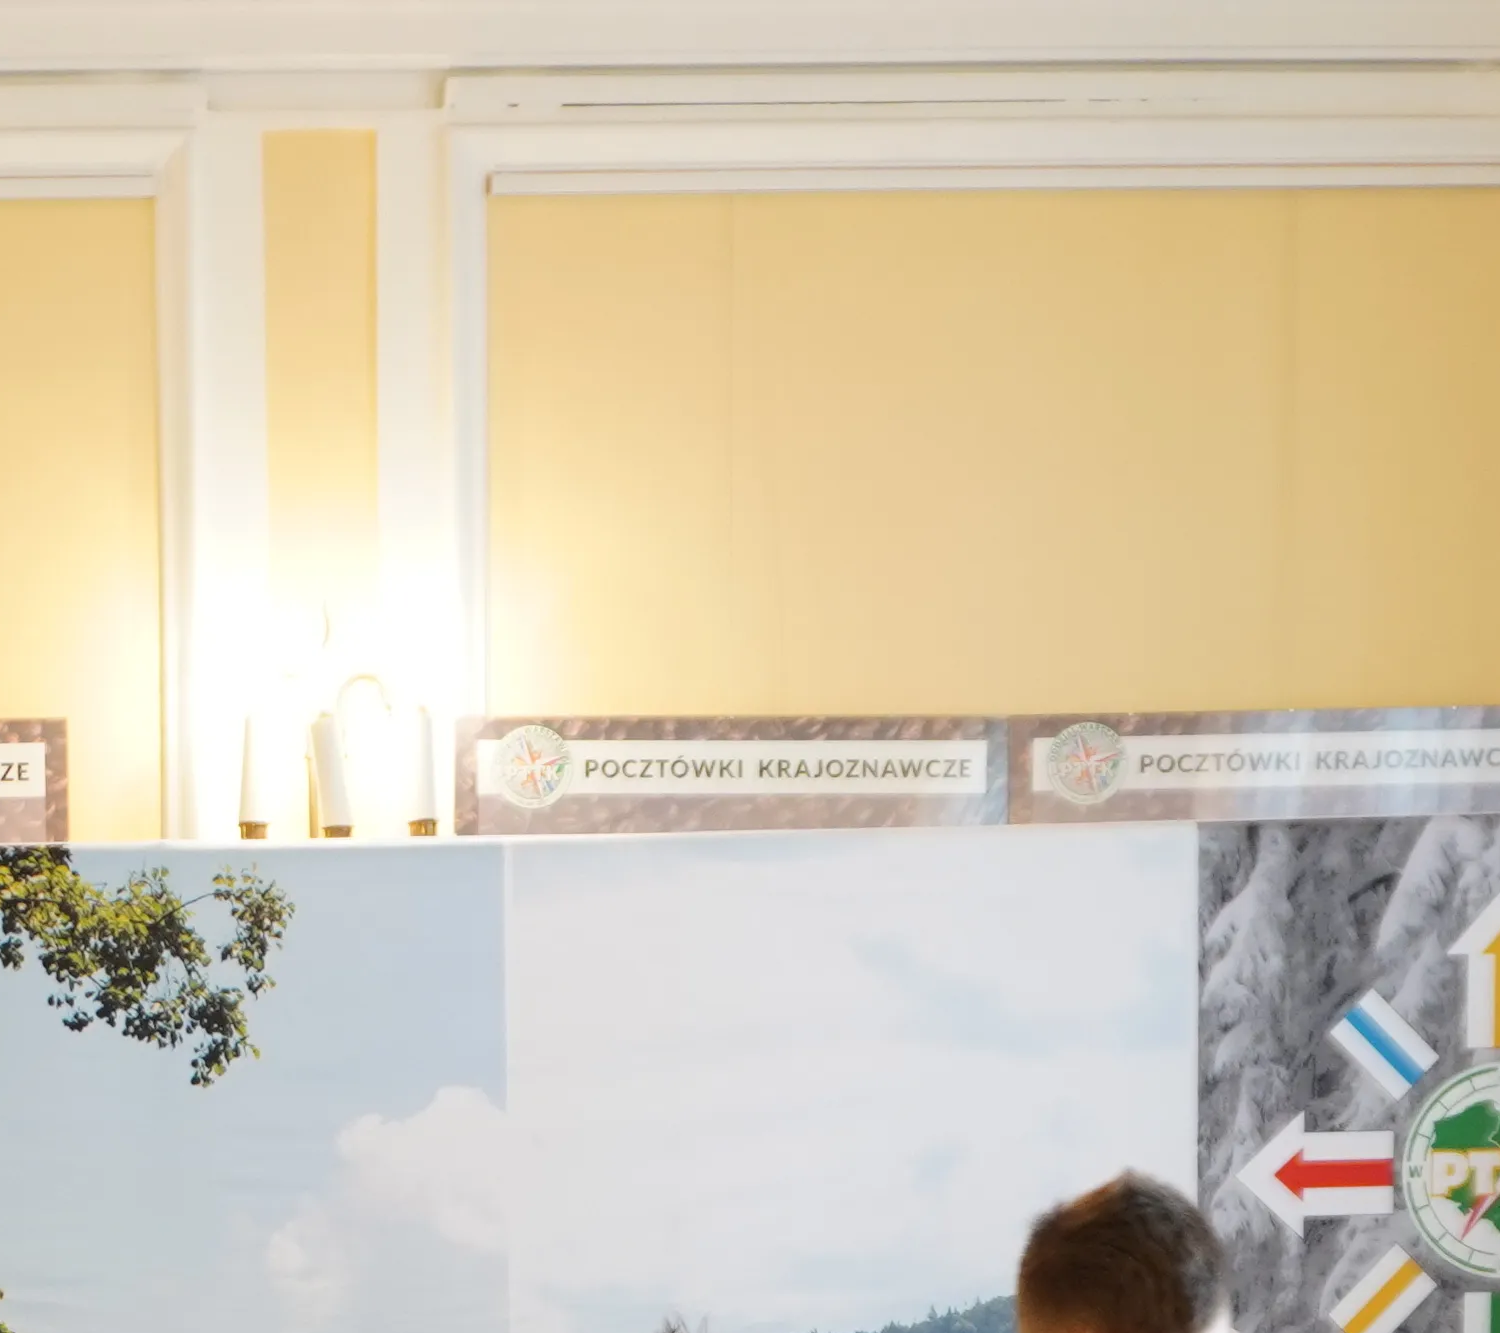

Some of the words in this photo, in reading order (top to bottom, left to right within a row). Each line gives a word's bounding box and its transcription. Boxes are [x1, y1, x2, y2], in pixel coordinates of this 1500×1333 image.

[585, 755, 743, 779] POCZTÓWKI
[758, 758, 971, 779] KRAJOZNAWCZE
[1140, 748, 1300, 775] POCZTÓWKI
